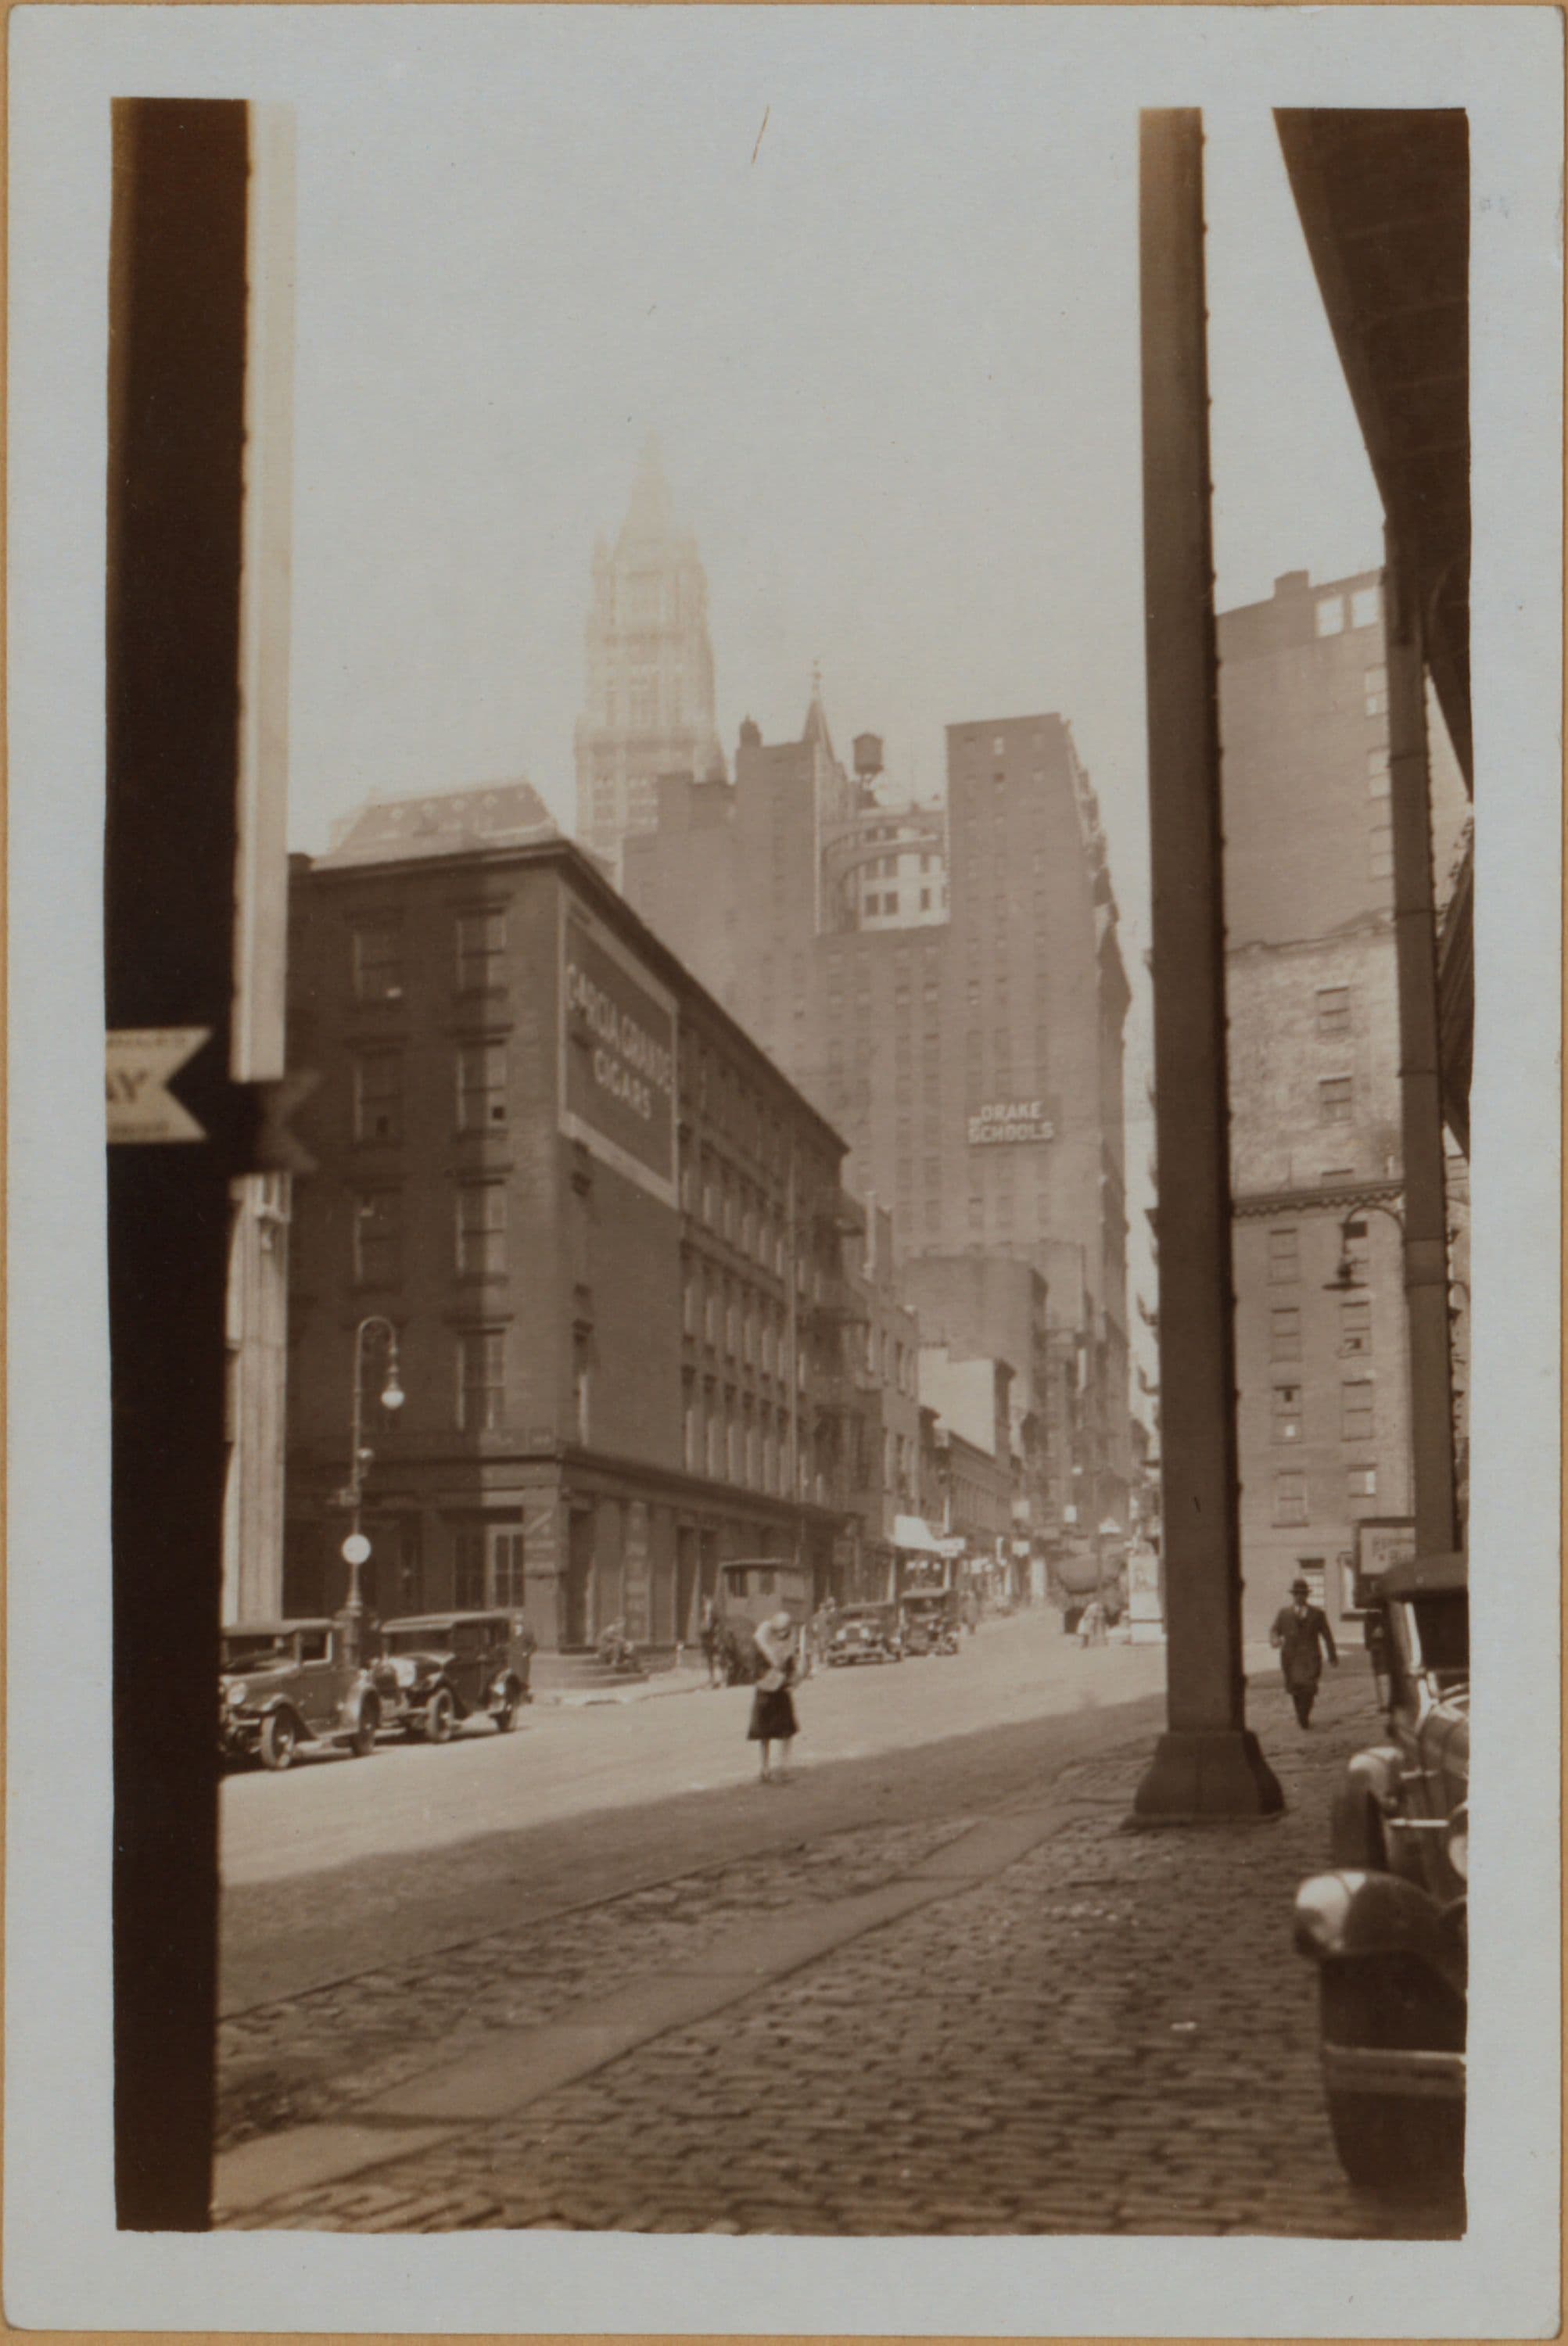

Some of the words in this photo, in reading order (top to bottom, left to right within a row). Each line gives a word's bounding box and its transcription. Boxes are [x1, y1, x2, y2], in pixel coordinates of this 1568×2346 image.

[594, 1049, 651, 1120] CIGARS
[981, 1100, 1043, 1121] DRAKE
[968, 1121, 1054, 1144] SCHOOLS
